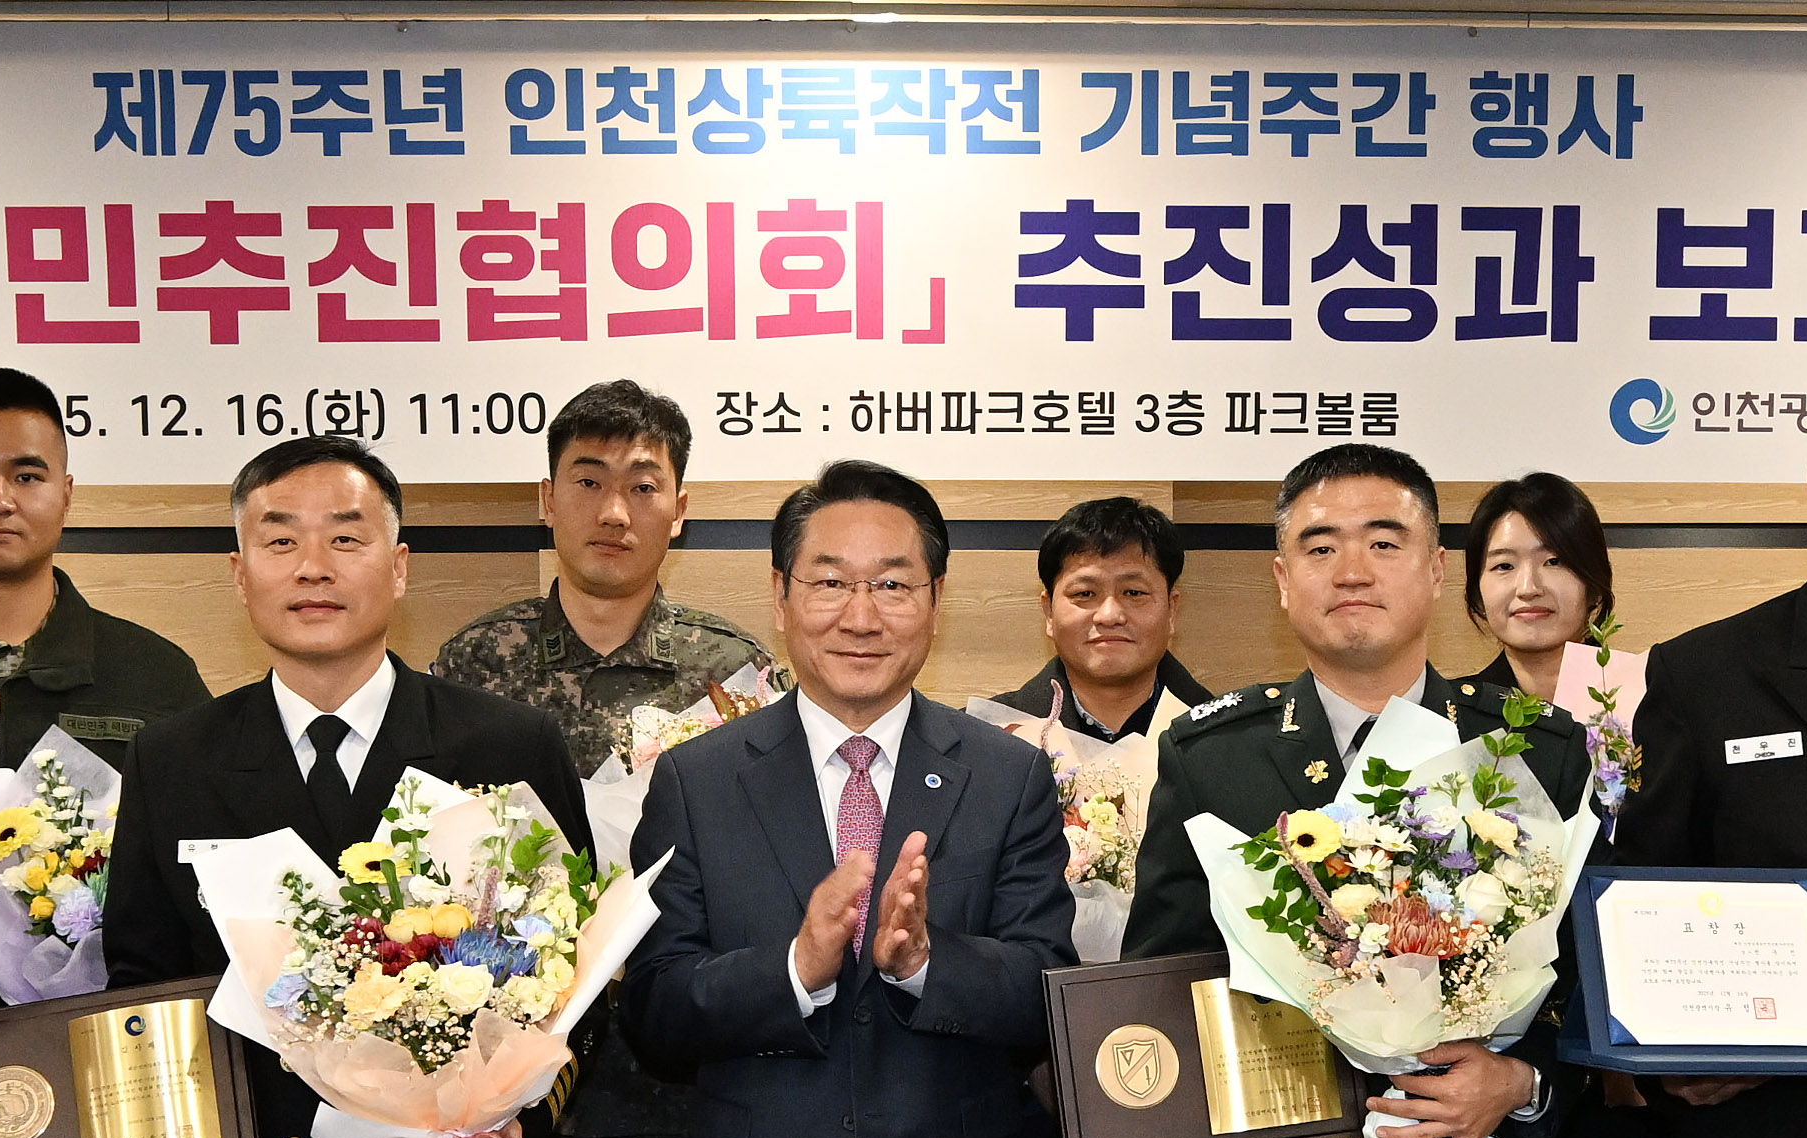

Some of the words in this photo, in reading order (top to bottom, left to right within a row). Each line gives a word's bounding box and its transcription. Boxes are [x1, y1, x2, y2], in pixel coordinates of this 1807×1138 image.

[93, 68, 467, 158] 제75주년
[504, 66, 1043, 156] 인천상륙작전
[1081, 69, 1438, 160] 기념주간
[1469, 70, 1646, 162] 행사
[1014, 198, 1597, 345] 추진성과
[131, 394, 205, 438] 12.
[409, 393, 546, 436] 11:00
[716, 391, 803, 437] 장소
[849, 389, 1117, 437] 하버파크호텔
[1135, 389, 1207, 438] 3층
[1224, 391, 1401, 438] 파크볼룸
